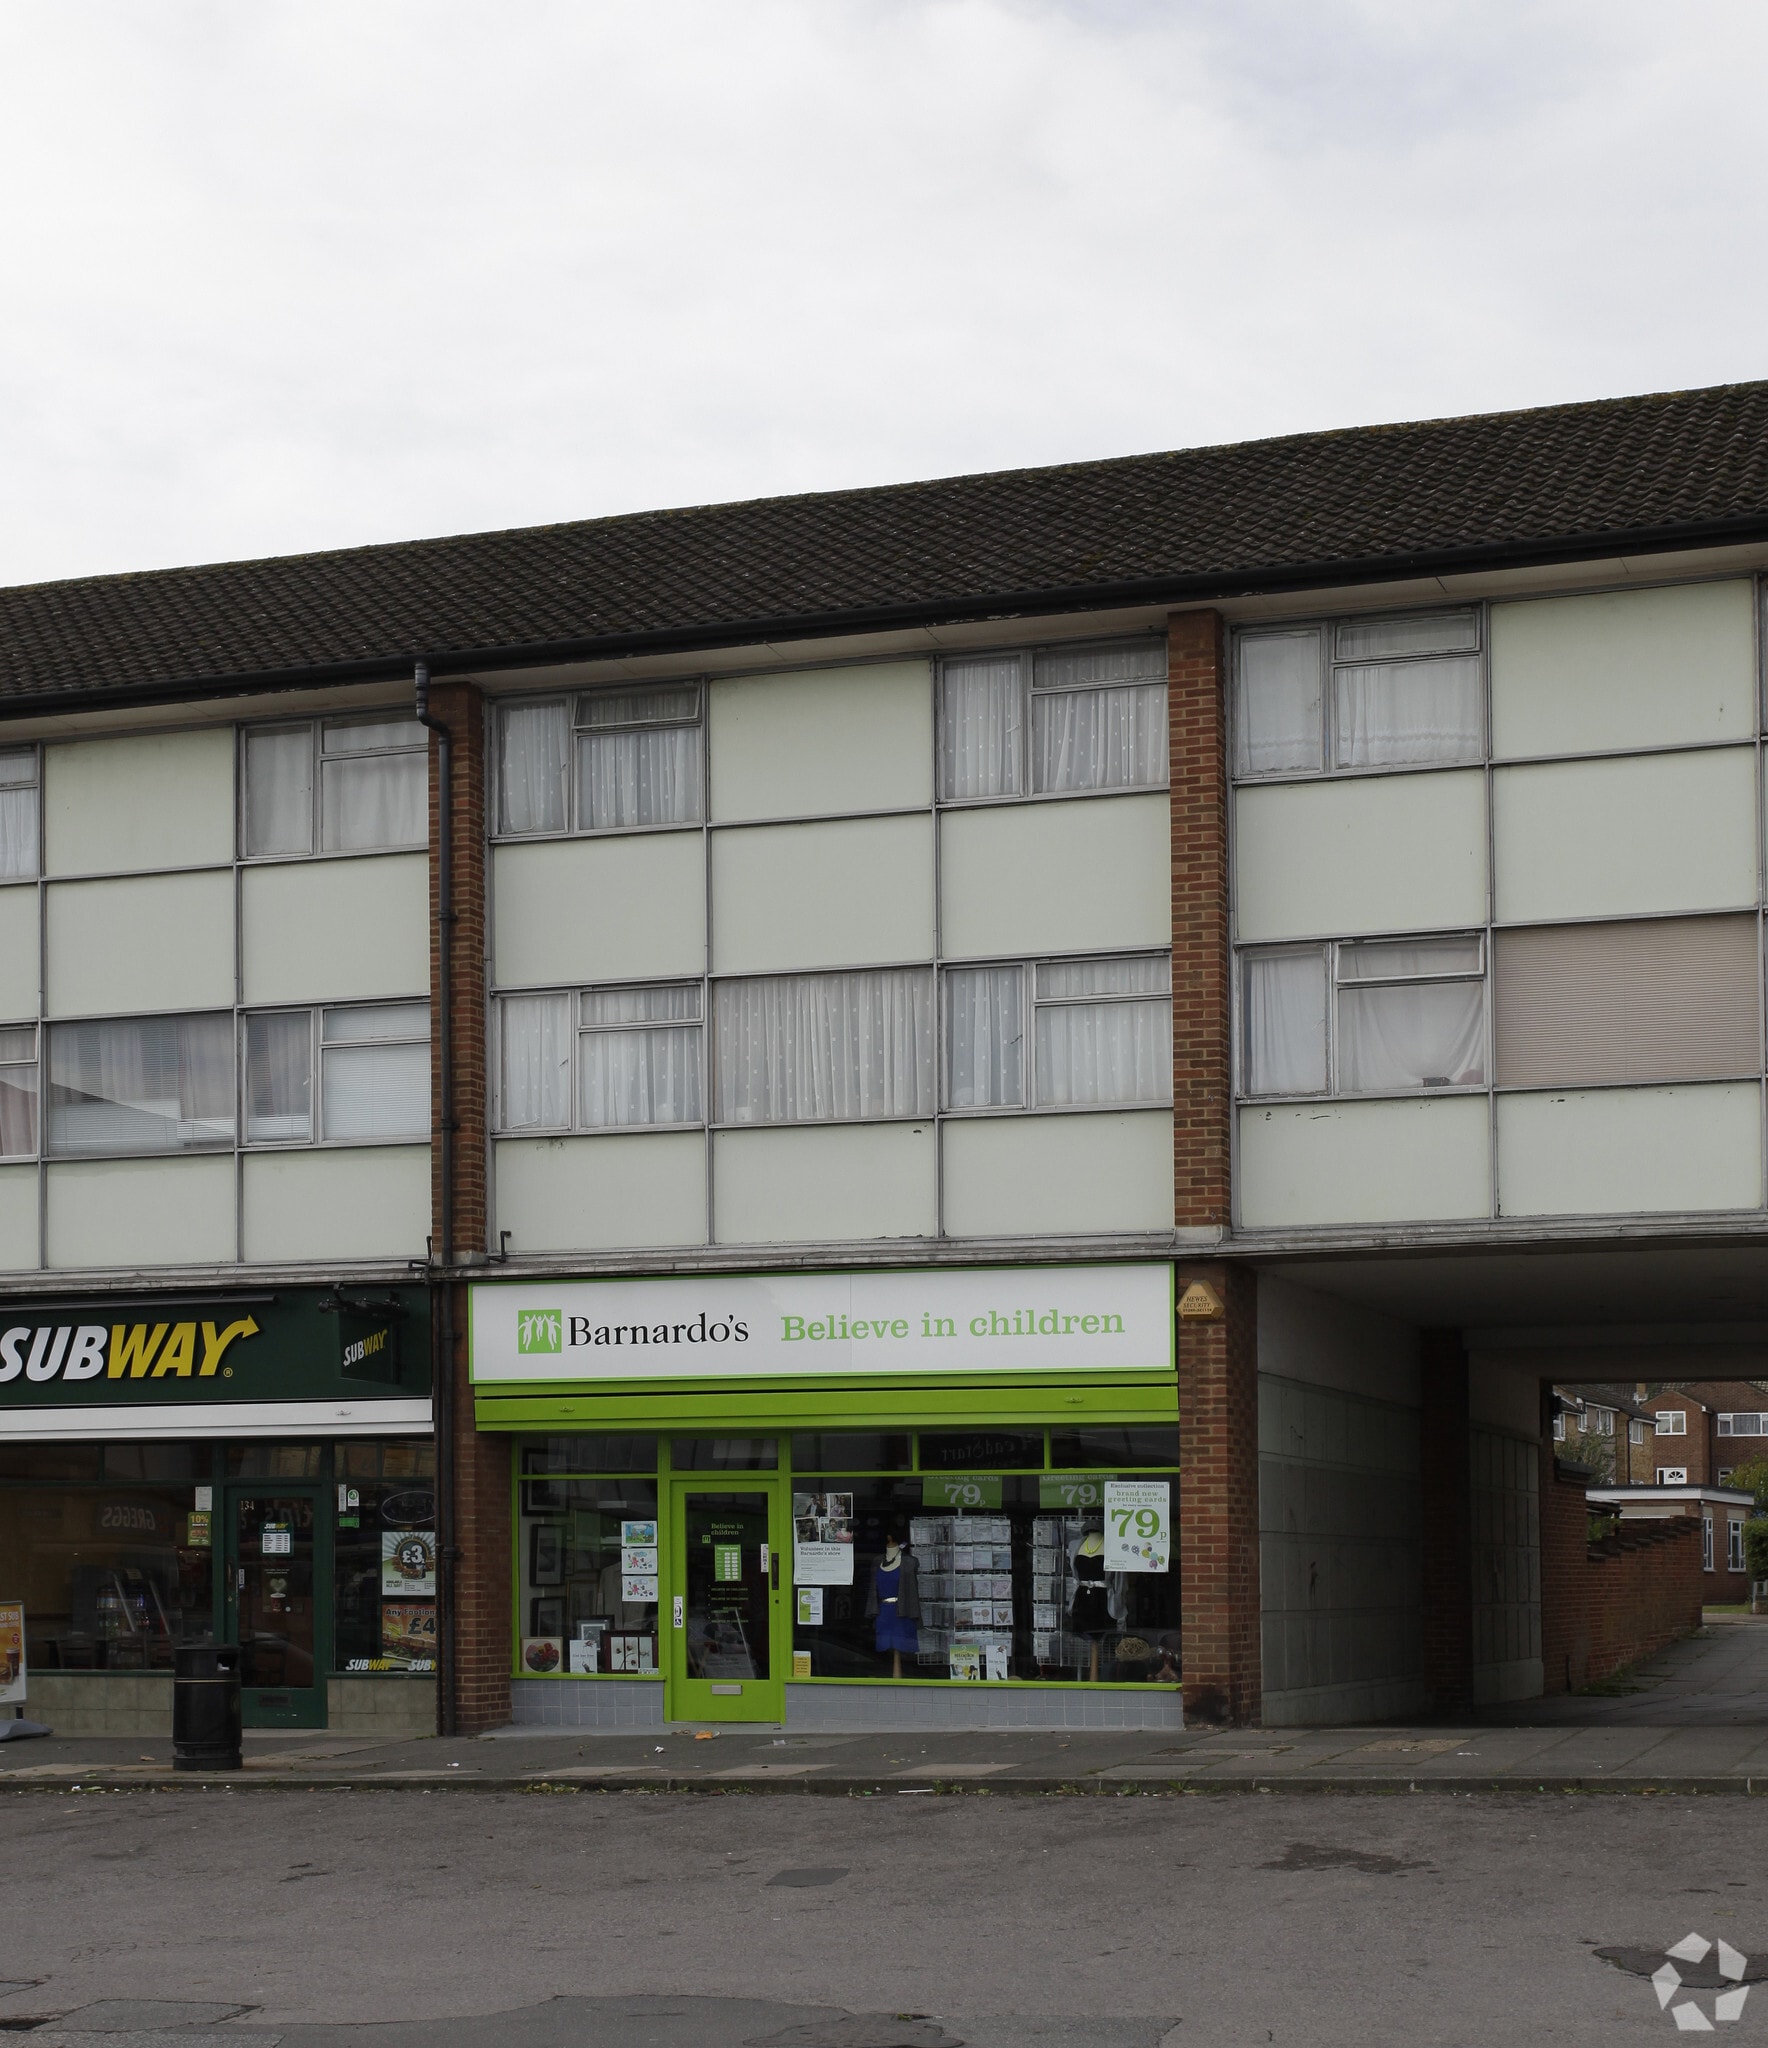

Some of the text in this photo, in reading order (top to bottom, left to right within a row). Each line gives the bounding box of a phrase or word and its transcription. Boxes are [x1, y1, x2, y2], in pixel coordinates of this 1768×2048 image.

[568, 1309, 1125, 1347] Barnardo's Believe in children
[0, 1314, 260, 1382] SUBWAY
[342, 1328, 389, 1367] SUBWAY
[240, 1500, 255, 1511] 134
[190, 1514, 209, 1523] 10%
[386, 1608, 402, 1616] Any
